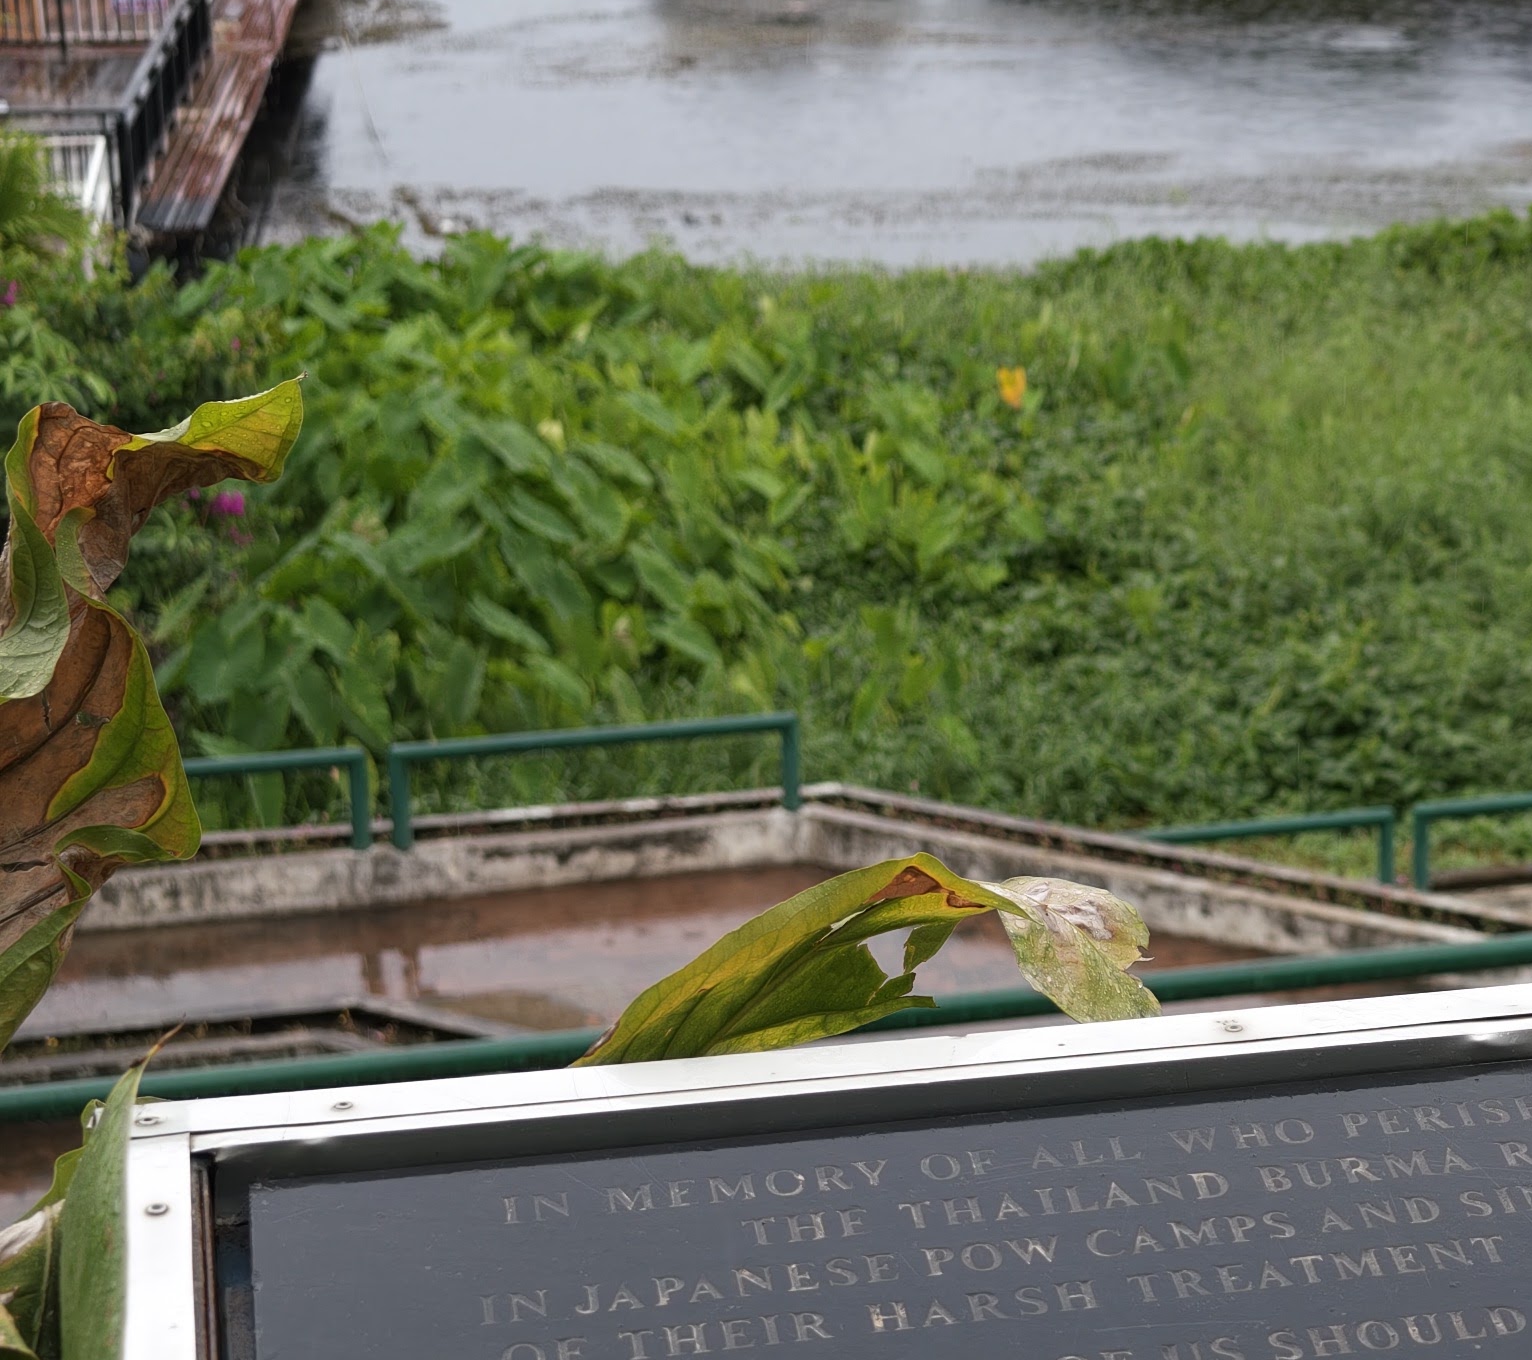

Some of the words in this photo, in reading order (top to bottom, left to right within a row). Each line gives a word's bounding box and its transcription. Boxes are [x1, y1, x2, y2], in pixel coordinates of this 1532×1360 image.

[502, 1192, 570, 1225] IN
[607, 1158, 888, 1216] MEMORY
[920, 1148, 998, 1182] OF
[1031, 1134, 1143, 1172] ALL
[1168, 1116, 1314, 1155] WHO
[741, 1207, 868, 1248] THE
[898, 1171, 1228, 1231] THAILAND
[1258, 1146, 1475, 1193] BURMA
[480, 1289, 549, 1326] IN
[574, 1252, 900, 1317] JAPANESE
[922, 1234, 1060, 1278] POW
[1085, 1210, 1296, 1259] CAMPS
[1321, 1195, 1442, 1234] AND
[867, 1280, 1098, 1335] HARSH
[1126, 1234, 1504, 1304] TREATMENT
